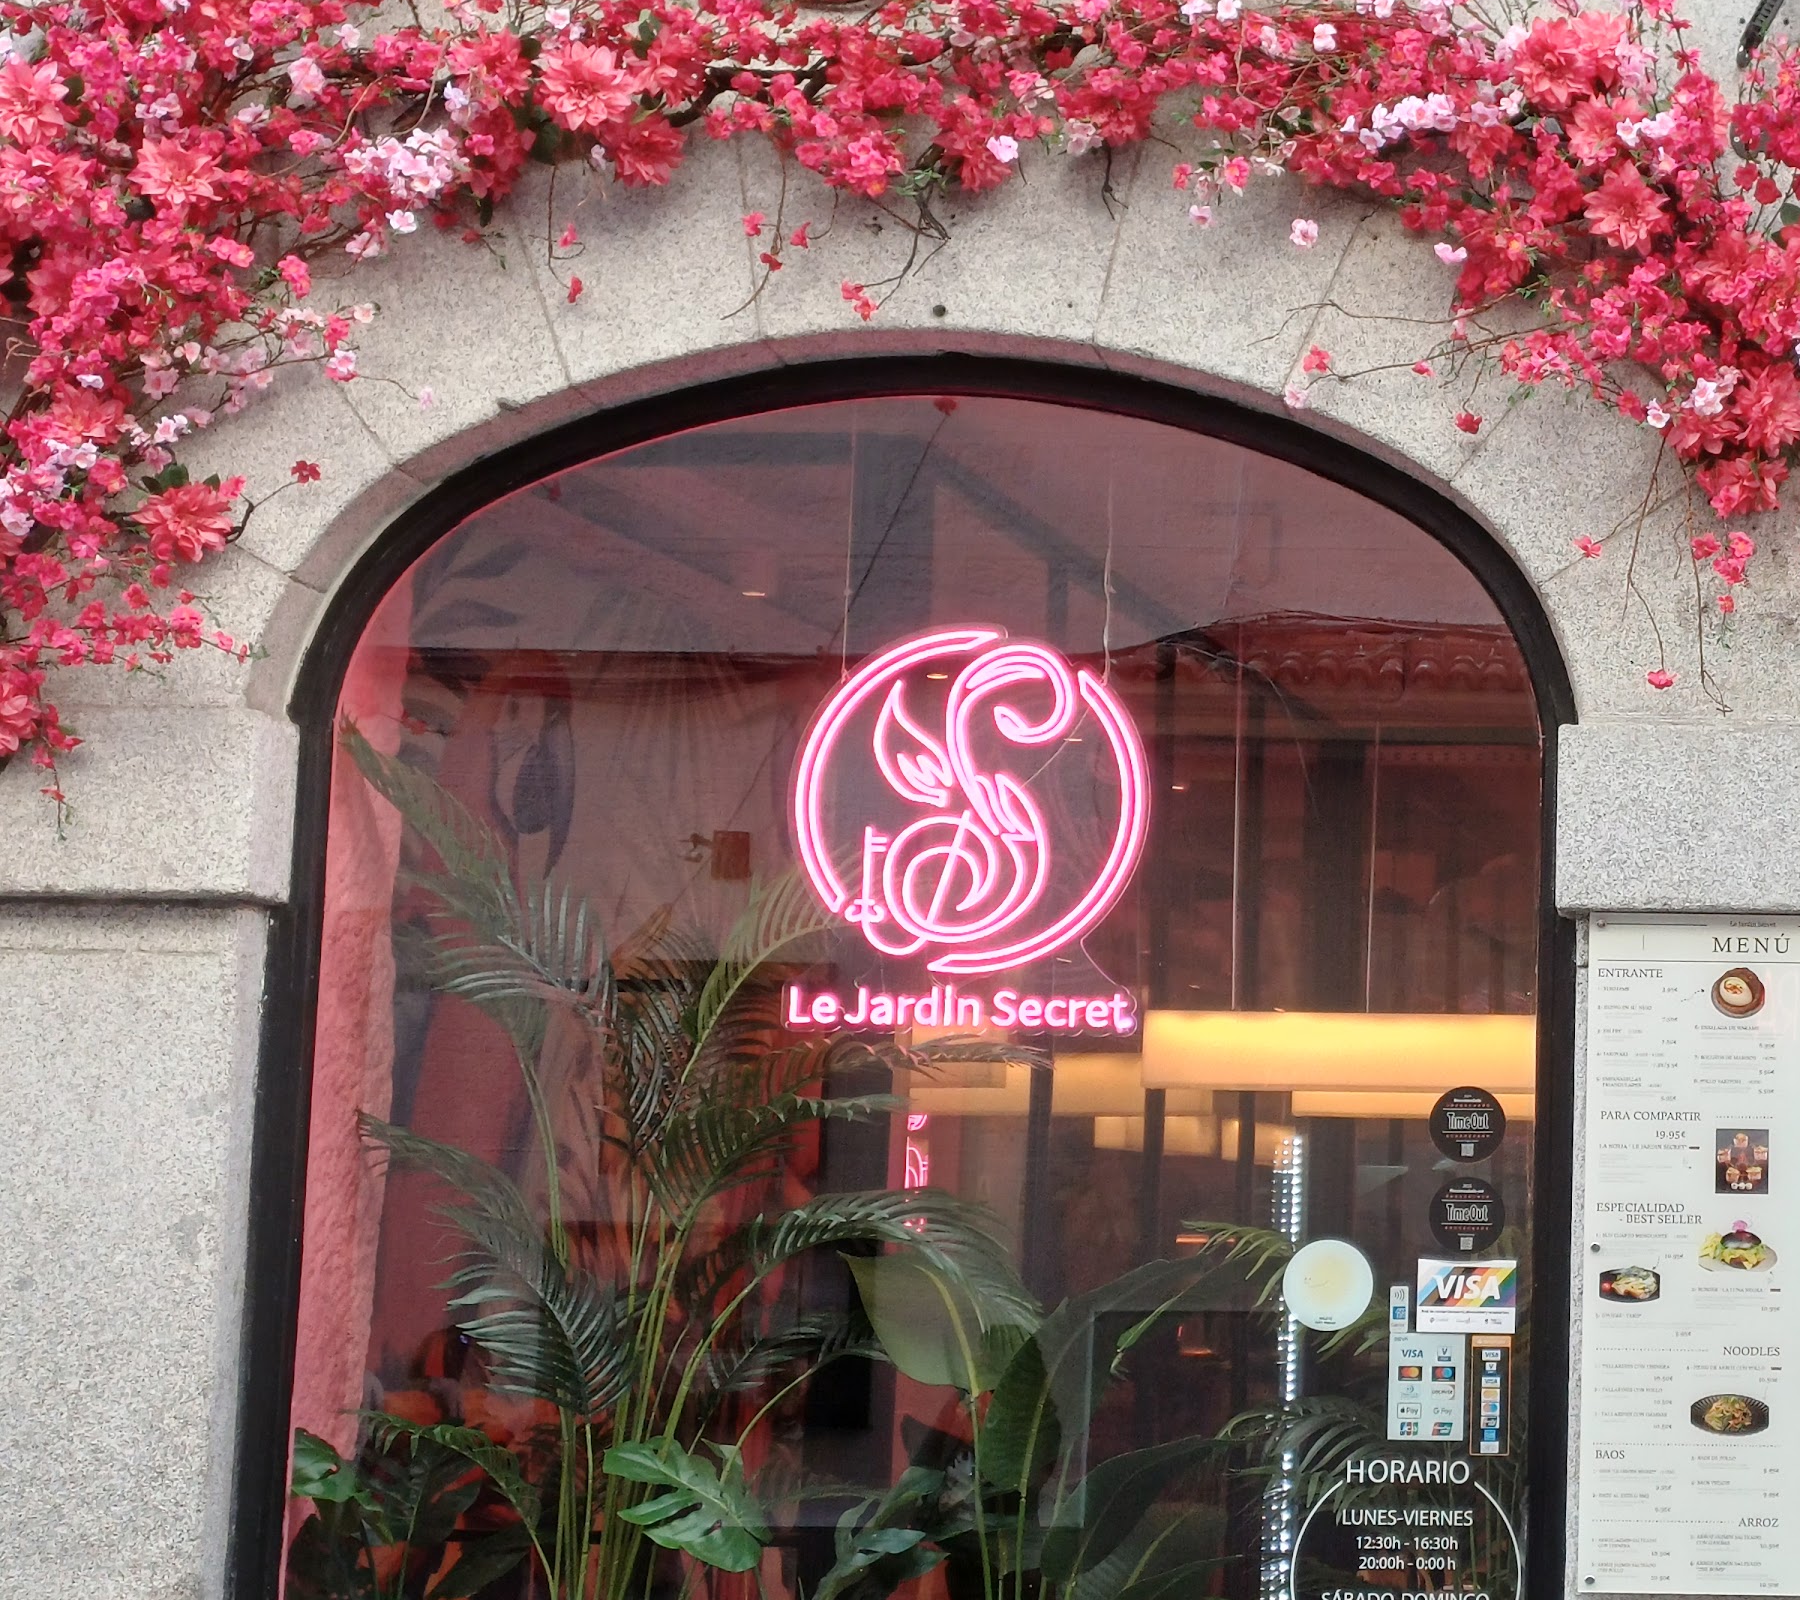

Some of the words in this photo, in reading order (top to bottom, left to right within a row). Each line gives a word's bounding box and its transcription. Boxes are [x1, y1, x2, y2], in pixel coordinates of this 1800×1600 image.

[1711, 933, 1792, 955] MENÚ
[1597, 967, 1663, 978] ENTRANTE
[787, 985, 838, 1026] Le
[843, 985, 980, 1028] Jardin
[990, 989, 1135, 1032] Secret
[1600, 1110, 1631, 1121] PARA
[1633, 1111, 1702, 1122] COMPARTIR
[1655, 1129, 1686, 1140] 19.95€
[1596, 1202, 1685, 1213] ESPECIALIDAD
[1626, 1213, 1655, 1224] BEST
[1657, 1214, 1703, 1225] SELLER
[1432, 1274, 1501, 1300] VISA
[1400, 1349, 1424, 1359] VISA
[1723, 1346, 1781, 1357] NOODLES
[1406, 1407, 1419, 1416] Pay
[1440, 1407, 1453, 1416] Pay
[1594, 1449, 1626, 1460] BAOS
[1346, 1459, 1470, 1485] HORARIO
[1342, 1509, 1474, 1527] LUNES-VIERNES
[1738, 1517, 1780, 1528] ARROZ
[1356, 1536, 1401, 1551] 12:30h
[1413, 1536, 1459, 1551] 16:30h
[1358, 1556, 1405, 1571] 20:00h
[1415, 1557, 1445, 1571] 0:00
[1447, 1556, 1456, 1571] h
